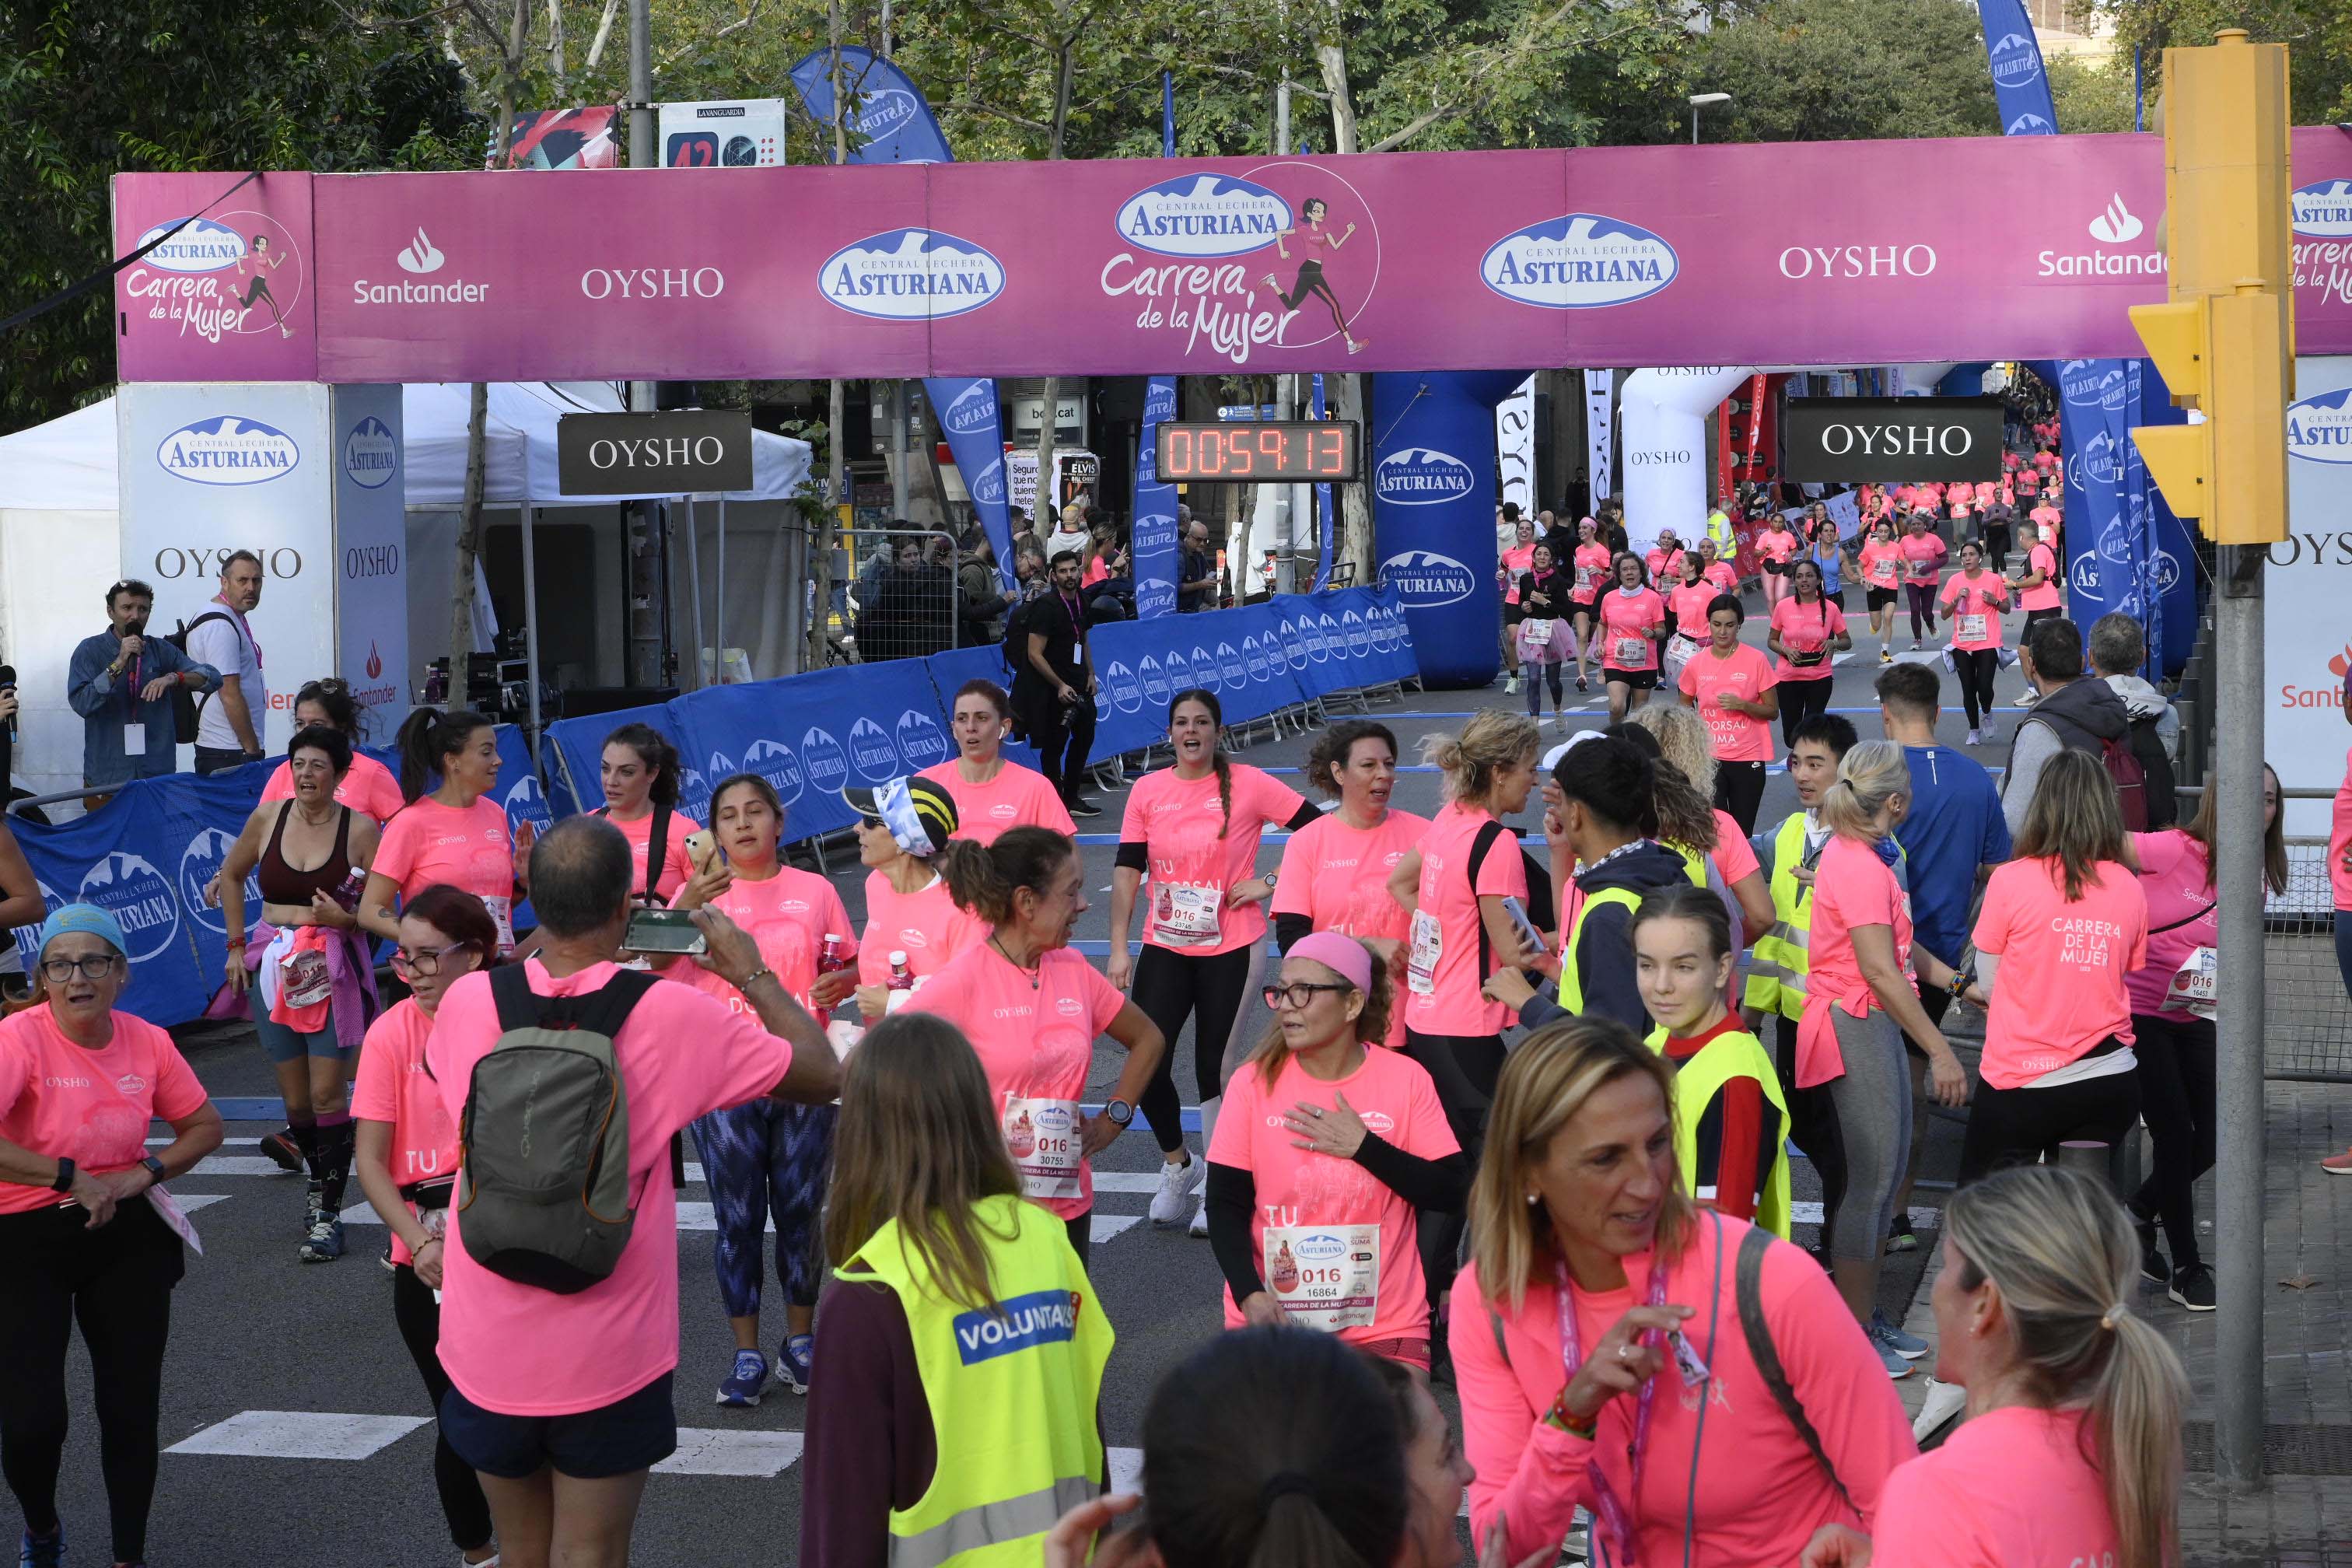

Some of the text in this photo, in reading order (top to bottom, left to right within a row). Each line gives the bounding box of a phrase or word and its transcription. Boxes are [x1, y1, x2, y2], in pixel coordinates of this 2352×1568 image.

[706, 108, 744, 117] VANGUARDIA
[1157, 201, 1274, 210] CENTRAL LECHERA
[2291, 208, 2352, 223] STURI
[1129, 205, 1279, 236] ASTURIANA
[1526, 245, 1657, 257] CENTRAL LECHERA
[2291, 242, 2352, 266] arrer
[862, 259, 985, 268] CENTRAL LECHERA
[1496, 250, 1664, 285] ASTURIANA
[1779, 244, 1937, 279] OYSHO
[2038, 250, 2168, 276] Santand
[127, 269, 219, 297] Carrera
[582, 267, 724, 299] OYSHO
[833, 261, 991, 297] ASTURIANA
[1101, 254, 1247, 296] Carrera
[354, 279, 489, 303] Santander
[149, 296, 253, 343] de la Mujer
[1136, 289, 1300, 364] de la Mujer
[2308, 415, 2352, 424] CENTRA
[239, 439, 285, 448] LECHERA
[1822, 424, 1972, 457] OYSHO
[168, 442, 290, 469] ASTURIANA
[348, 444, 394, 471] ASTURIANA
[589, 436, 724, 469] OYSHO
[1169, 429, 1343, 474] 00:59:13
[1631, 450, 1691, 466] OYSHO
[1071, 464, 1095, 474] ELVIS
[1013, 485, 1038, 496] quiere
[1378, 471, 1467, 492] ASTURIANA
[2265, 532, 2352, 567] OYS
[346, 544, 398, 579] OYSHO
[1703, 709, 1716, 717] TU
[854, 744, 895, 768] ASTURIANA
[808, 755, 845, 779] ASTURIANA
[1156, 859, 1174, 875] TU
[1323, 858, 1358, 870] OYSHO
[2182, 887, 2209, 906] Sports
[112, 894, 175, 934] TURIANA
[1174, 909, 1195, 921] 016
[2052, 917, 2122, 940] CARRERA
[1416, 943, 1428, 957] 016
[2065, 933, 2108, 951] DE LA
[2060, 948, 2109, 967] MUJER
[2192, 975, 2212, 988] 016
[729, 991, 817, 1016] DOAL
[2022, 1059, 2066, 1071] OYSHO
[46, 1076, 89, 1088] OYSHO
[1038, 1137, 1067, 1152] 016
[406, 1149, 437, 1174] TU
[1040, 1155, 1064, 1166] 30755
[1265, 1205, 1298, 1227] TU
[1299, 1244, 1342, 1255] ASTURIANA
[1301, 1268, 1342, 1283] 016
[1307, 1288, 1338, 1297] 16864
[1290, 1316, 1310, 1325] SHO
